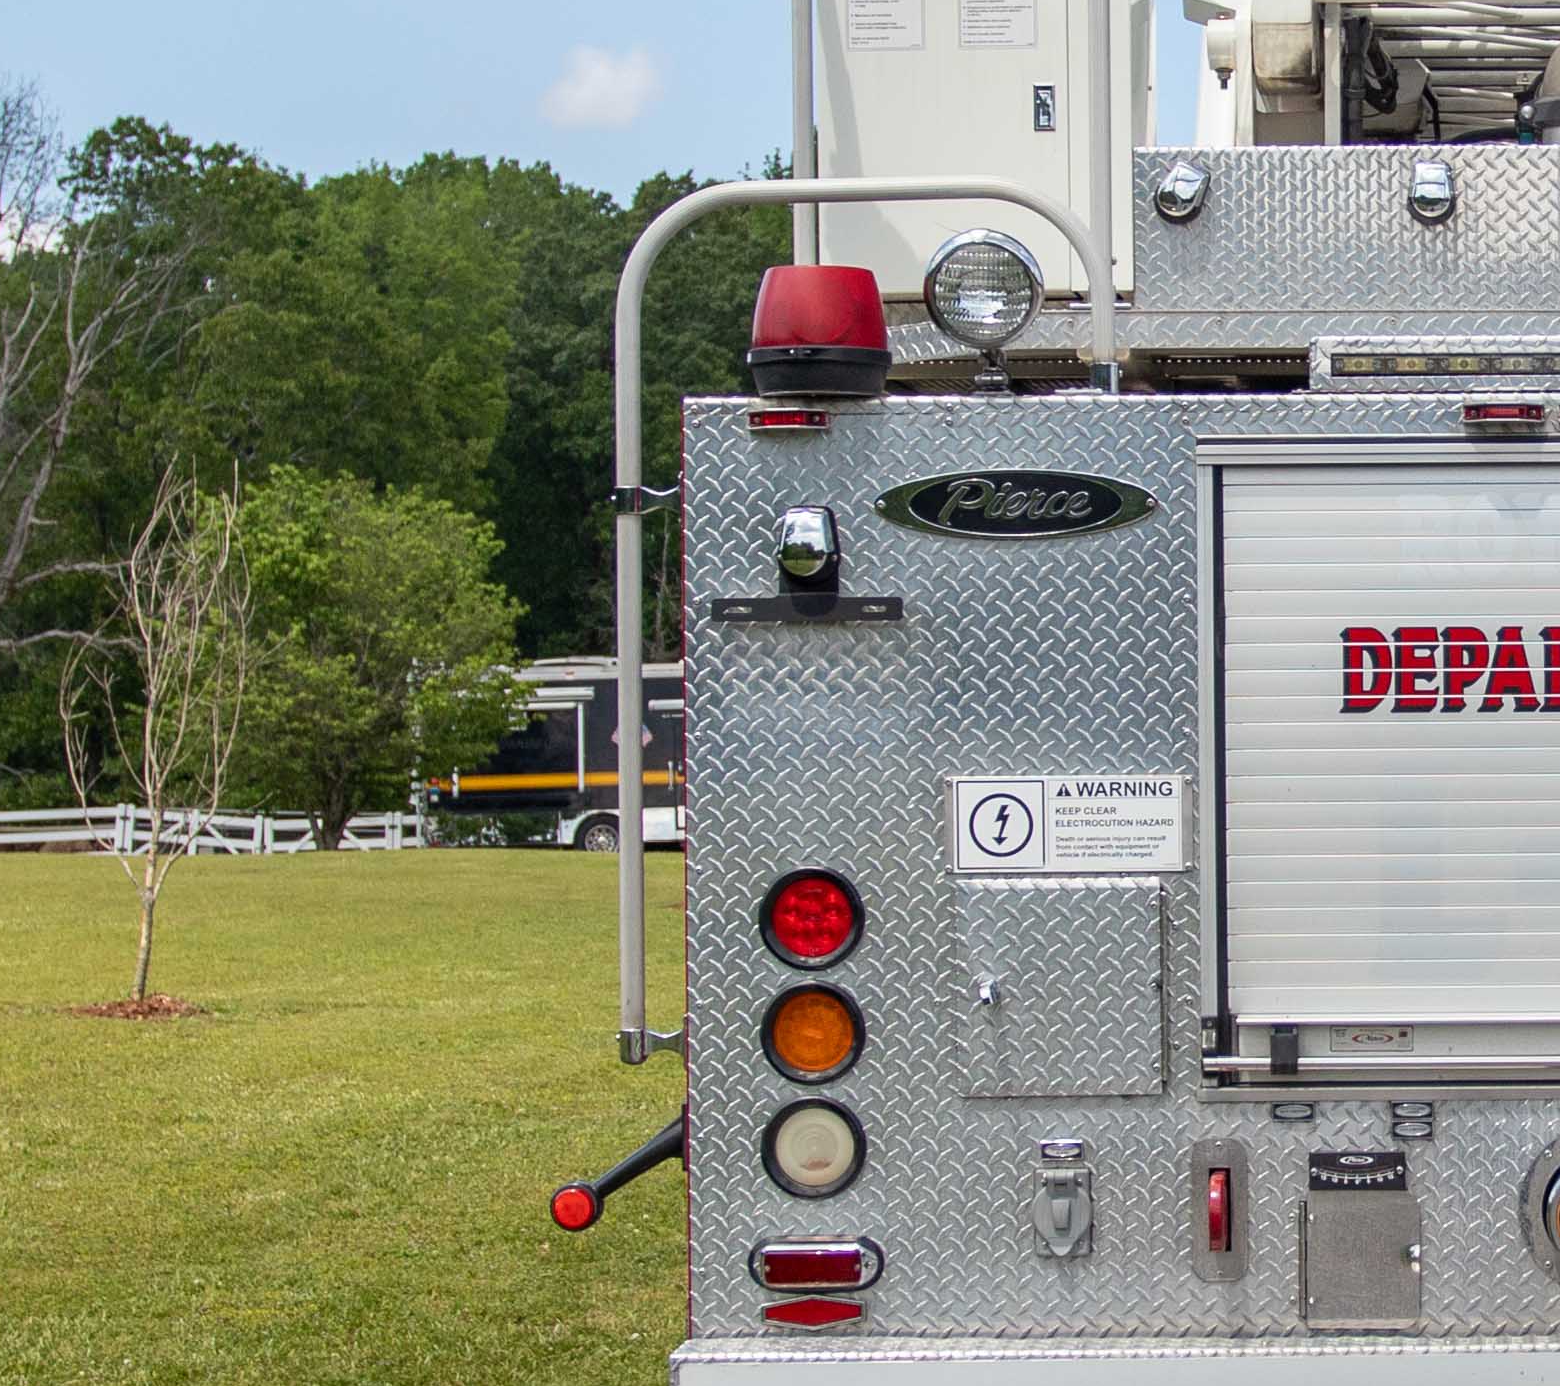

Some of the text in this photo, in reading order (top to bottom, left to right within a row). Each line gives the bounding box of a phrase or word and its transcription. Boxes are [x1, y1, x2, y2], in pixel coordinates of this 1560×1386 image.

[937, 477, 1093, 527] Pierce
[1076, 781, 1173, 797] WARNING
[1055, 806, 1117, 815] KEEP CLEAR
[1055, 818, 1174, 828] ELECTROCUTION HAZARD
[1087, 851, 1123, 859] electrically
